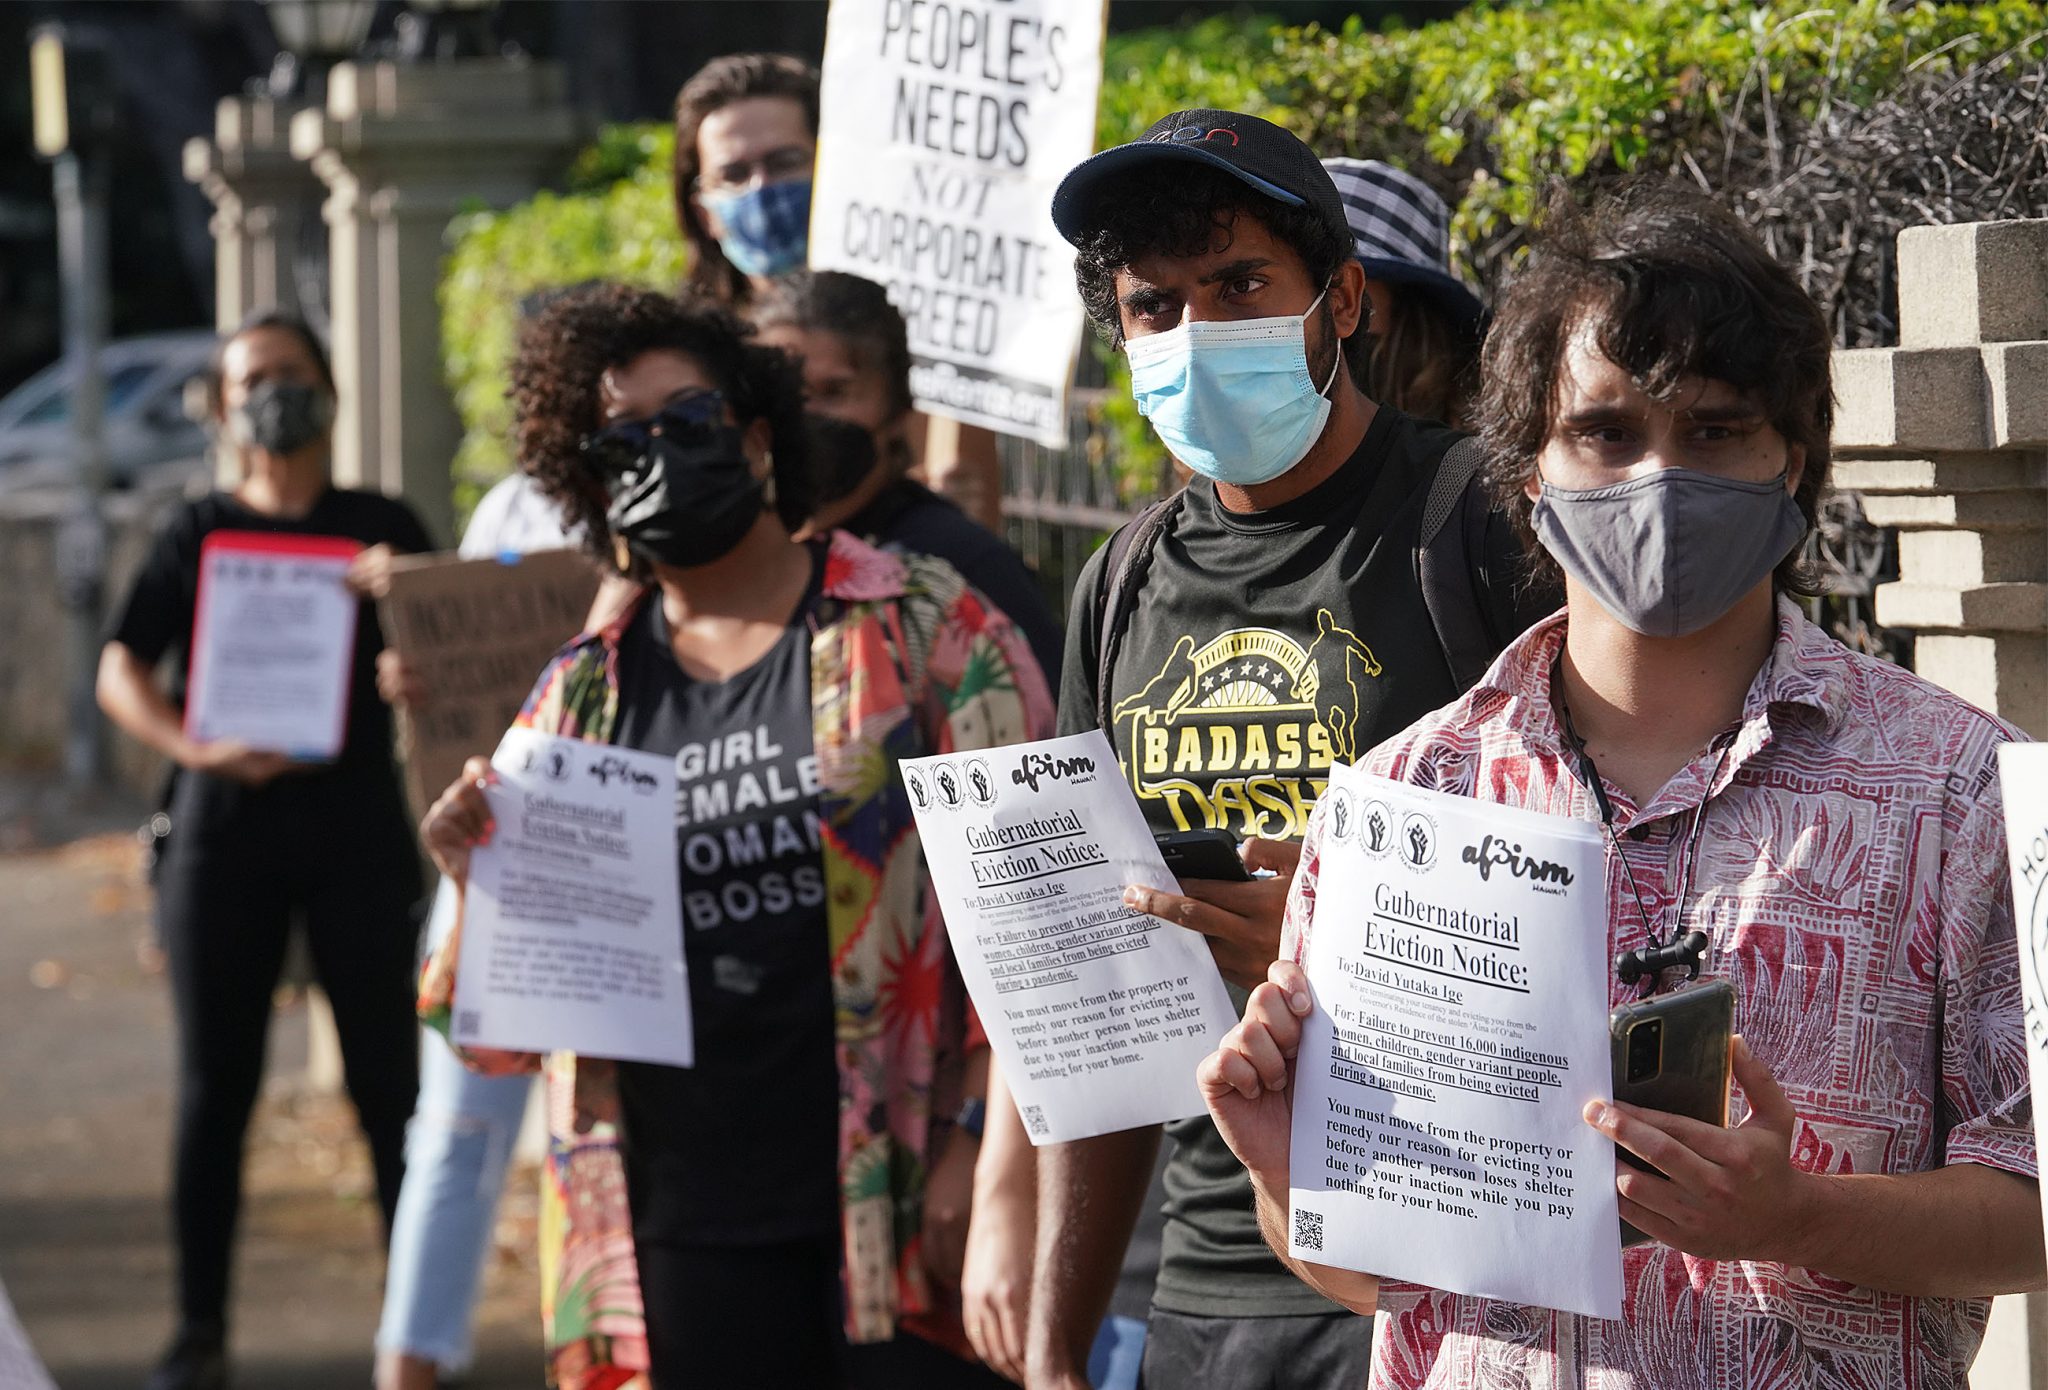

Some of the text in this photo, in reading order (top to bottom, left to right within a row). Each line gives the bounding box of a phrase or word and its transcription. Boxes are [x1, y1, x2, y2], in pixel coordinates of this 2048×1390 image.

[880, 0, 1067, 92] PEOPLE'S
[891, 77, 1030, 168] NEEDS
[908, 164, 997, 219] NOT
[844, 201, 1048, 299] CORPORATE
[675, 724, 783, 782] GIRL
[1144, 723, 1335, 774] BADASS
[677, 754, 823, 828] EMALE
[1142, 774, 1329, 841] DASH
[965, 808, 1083, 849] Gubernatorial
[970, 841, 1104, 882] Eviction Notice:
[684, 865, 824, 932] BOSS
[1005, 886, 1046, 902] Yutaka
[1045, 882, 1067, 897] Ige
[1374, 883, 1518, 943] Gubernatorial
[975, 934, 996, 946] For:
[994, 930, 1027, 945] Failure
[1026, 928, 1037, 937] to
[1037, 919, 1076, 939] prevent
[989, 933, 1150, 976] and local families from being evicted
[1055, 933, 1089, 950] gender
[1088, 924, 1125, 942] variant
[1365, 921, 1527, 985] Eviction Notice:
[994, 968, 1079, 993] during a pandemic.
[1004, 976, 1188, 1020] You must move from the property or
[1394, 972, 1438, 996] Yutaka
[1441, 984, 1463, 1005] Ige
[1011, 991, 1195, 1036] remedy our reason for evicting you
[1015, 1006, 1200, 1050] before another person loses shelter
[1334, 1003, 1568, 1070] For: Failure to prevent 16,000 indigenous
[1023, 1022, 1206, 1065] due to your inaction while you pay
[1029, 1052, 1144, 1080] nothing for your home.
[1331, 1024, 1562, 1087] women, children, gender variant people,
[1329, 1061, 1436, 1101] during a pandemic.
[1331, 1043, 1539, 1101] and local families from being evicted
[1326, 1119, 1572, 1178] remedy our reason for evicting you
[1327, 1096, 1573, 1159] You must move from the property or
[1325, 1154, 1574, 1219] due to your inaction while you pay
[1326, 1134, 1574, 1197] before another person loses shelter
[1325, 1176, 1477, 1219] nothing for your home.
